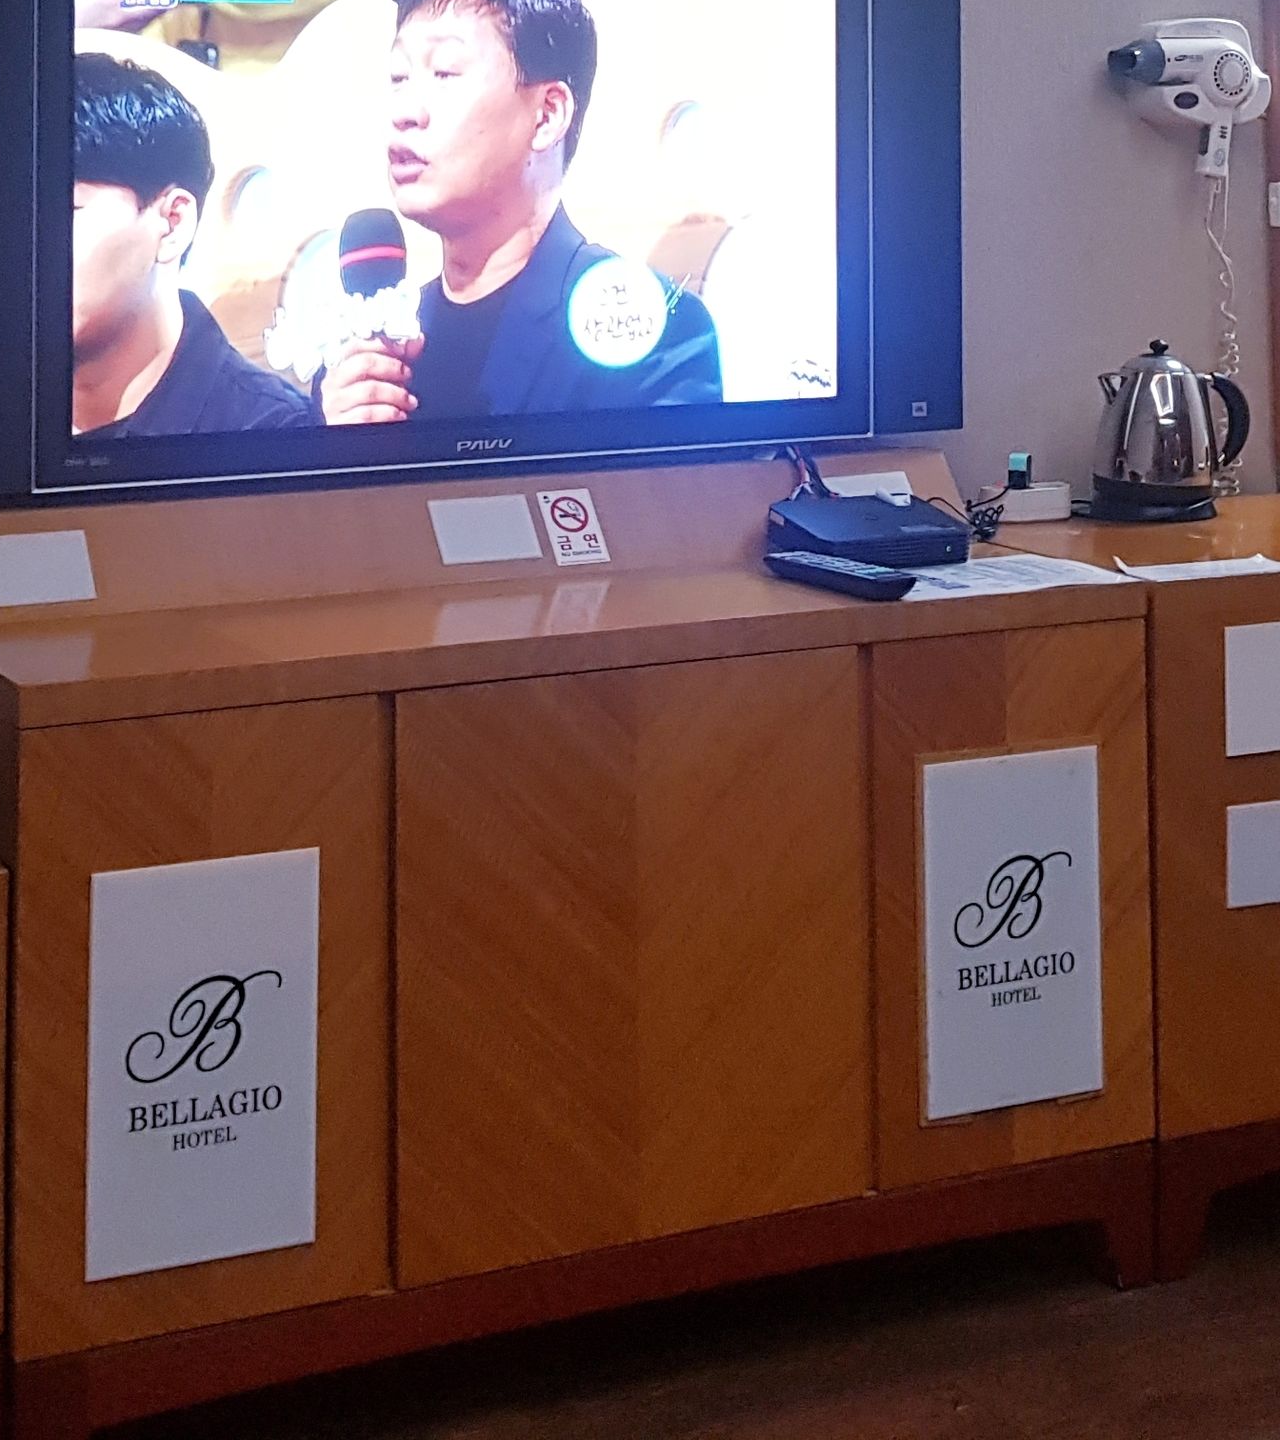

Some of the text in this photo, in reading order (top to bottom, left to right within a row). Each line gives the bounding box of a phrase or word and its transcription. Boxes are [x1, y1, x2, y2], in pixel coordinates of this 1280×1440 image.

[456, 438, 513, 452] PAVV
[958, 950, 1076, 991] BELLAGIO
[991, 987, 1042, 1008] HOTEL
[127, 1084, 283, 1134] BELLAGIO
[172, 1126, 237, 1152] HOTEL
